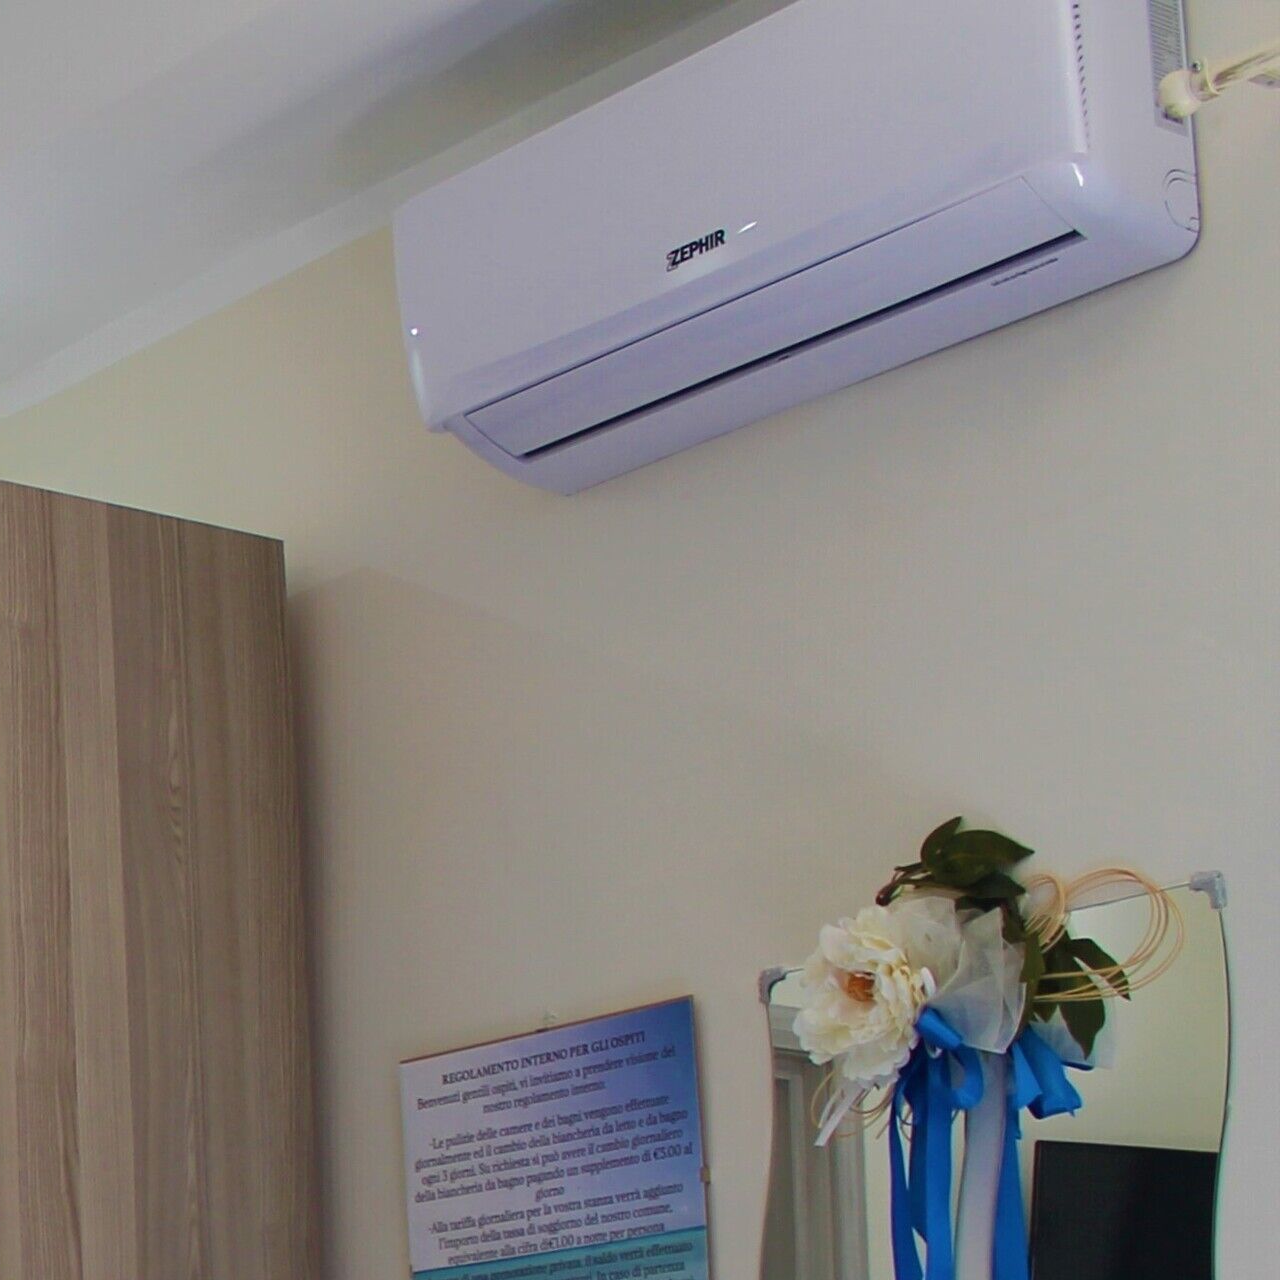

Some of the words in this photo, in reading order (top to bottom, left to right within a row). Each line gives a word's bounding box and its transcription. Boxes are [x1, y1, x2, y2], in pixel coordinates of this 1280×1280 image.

[668, 229, 726, 269] ZEPHIR
[441, 1056, 520, 1086] REGOLAMENTO
[520, 1045, 568, 1068] INTERNO
[569, 1041, 589, 1058] PER
[590, 1036, 609, 1053] GLI
